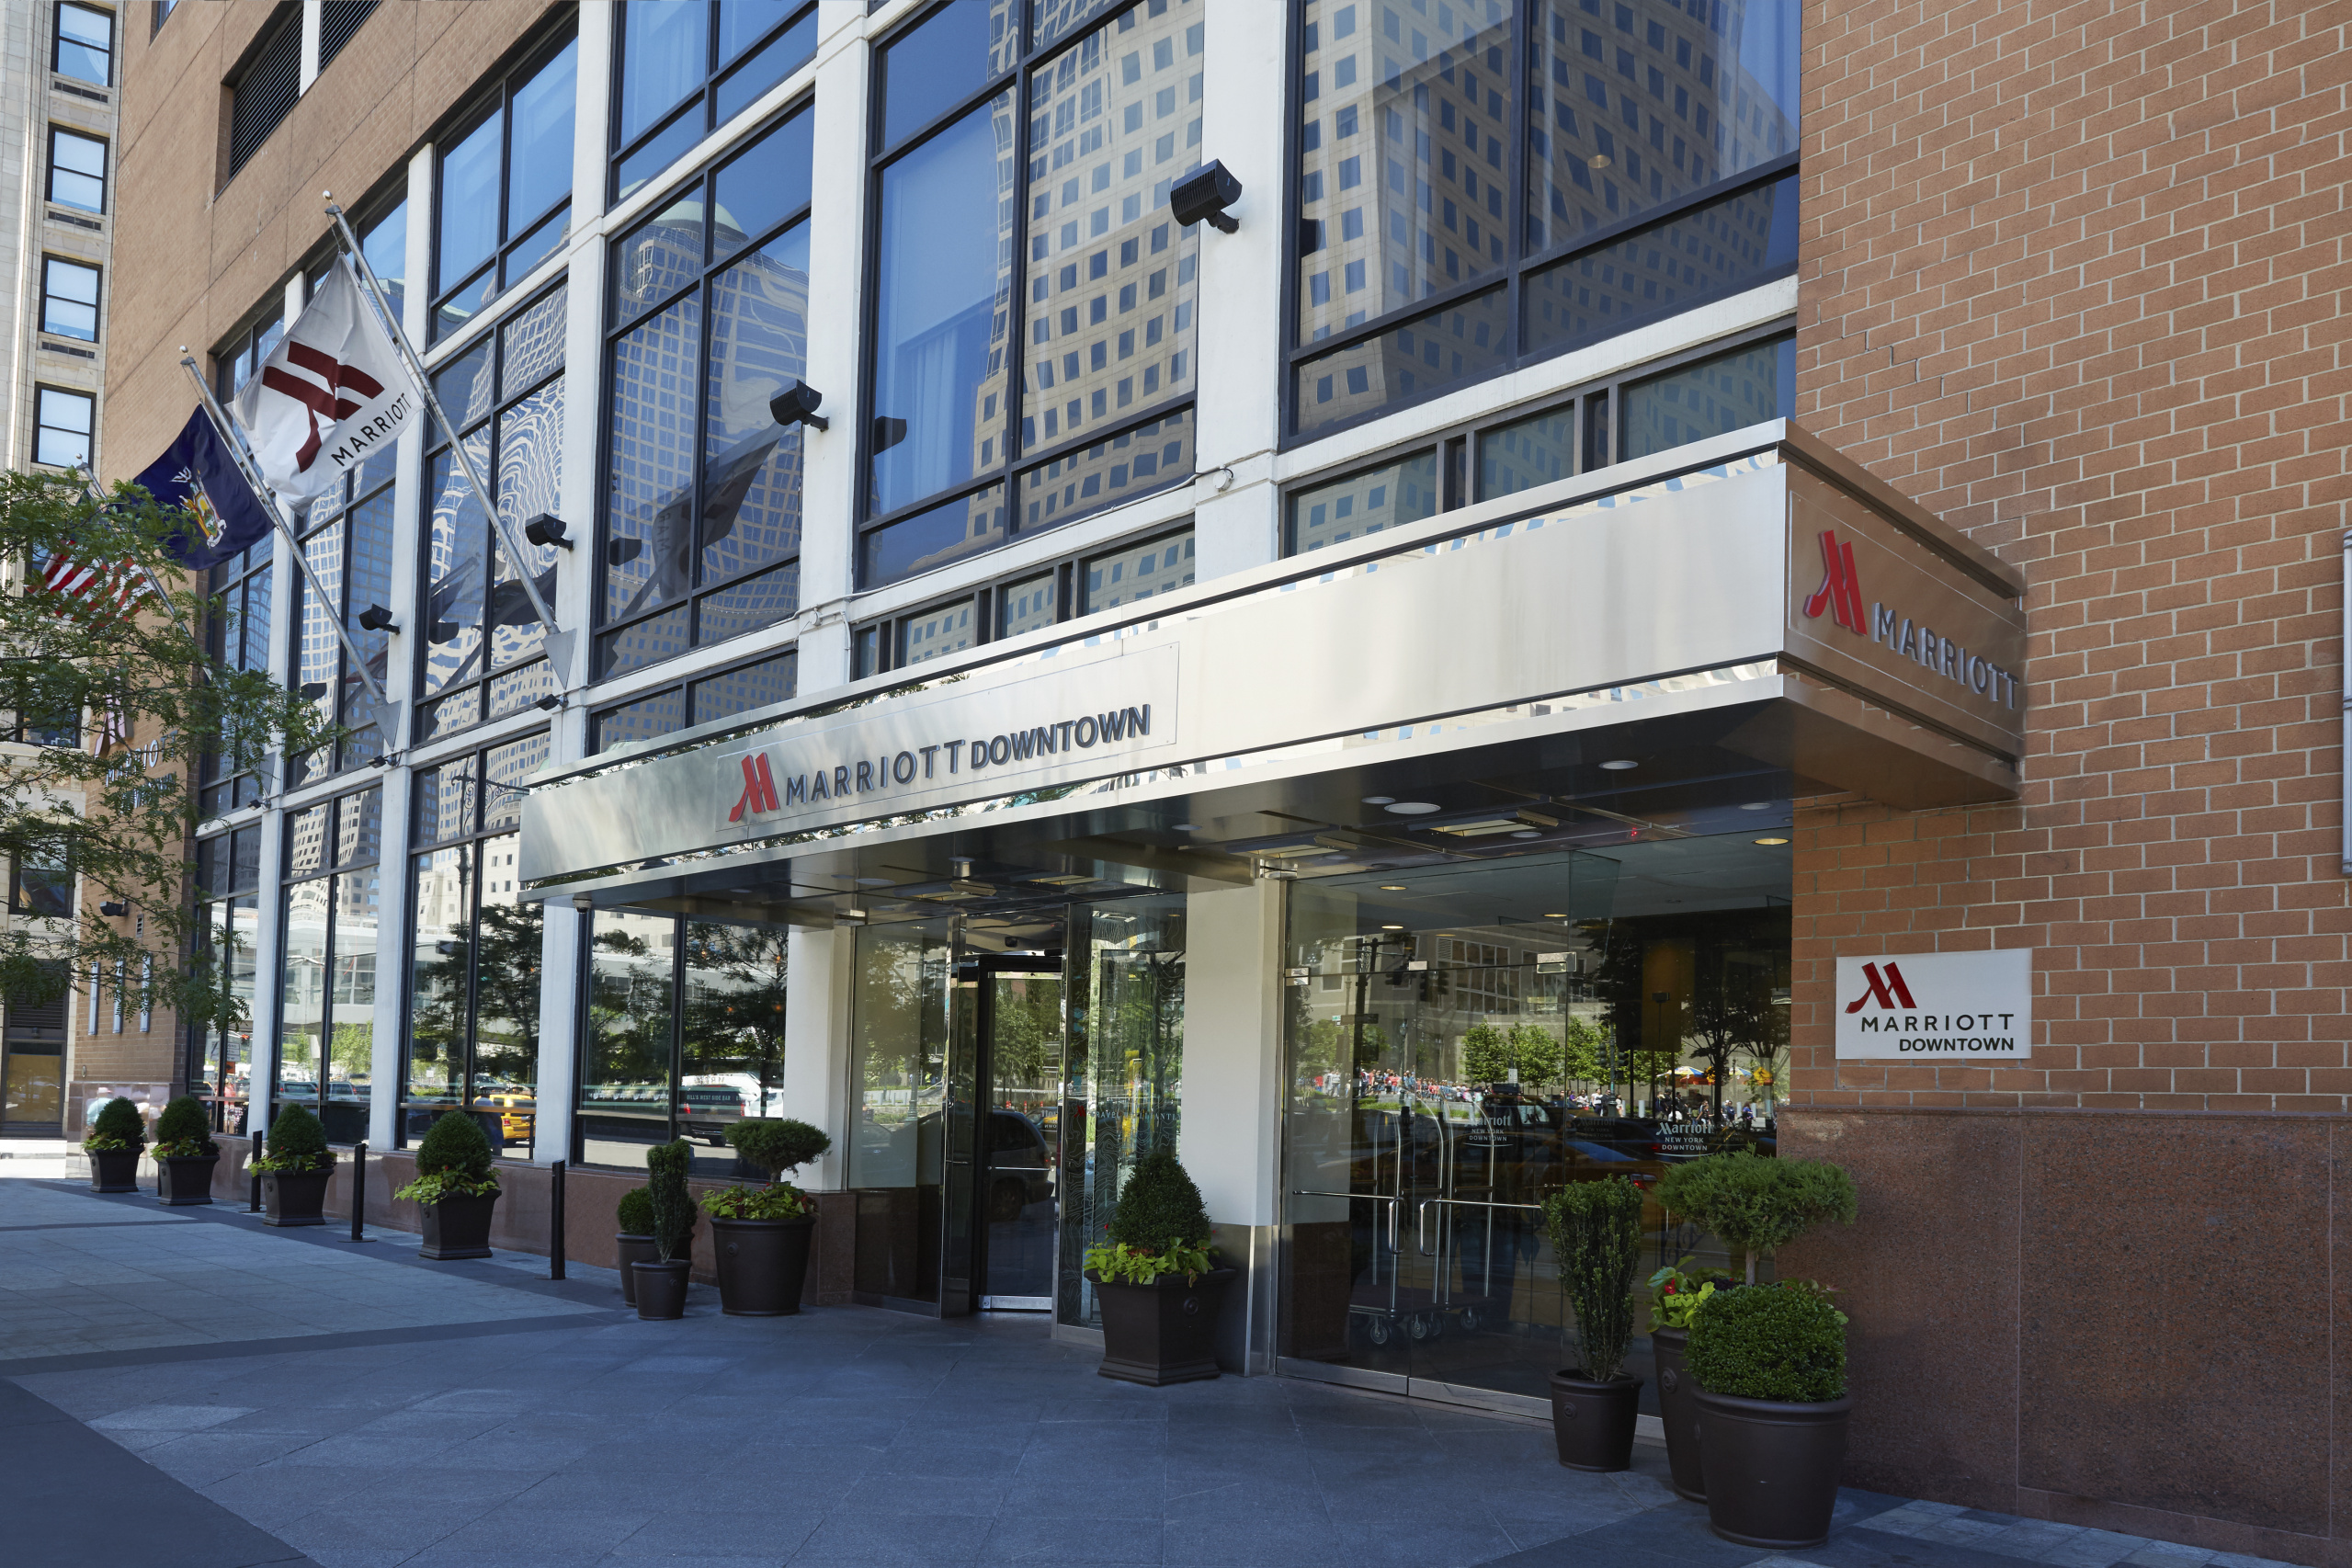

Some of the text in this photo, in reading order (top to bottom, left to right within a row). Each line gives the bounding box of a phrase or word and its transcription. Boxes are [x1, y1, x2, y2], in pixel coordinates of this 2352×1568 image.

[331, 392, 412, 467] MARRIOTT
[1870, 602, 2018, 710] MARRIOTT
[786, 703, 1151, 807] MARRIOTT DOWNTOWN
[1861, 1014, 2015, 1032] MARRIOTT
[1899, 1037, 2015, 1052] DOWNTOWN
[1655, 1121, 1712, 1136] Marriott
